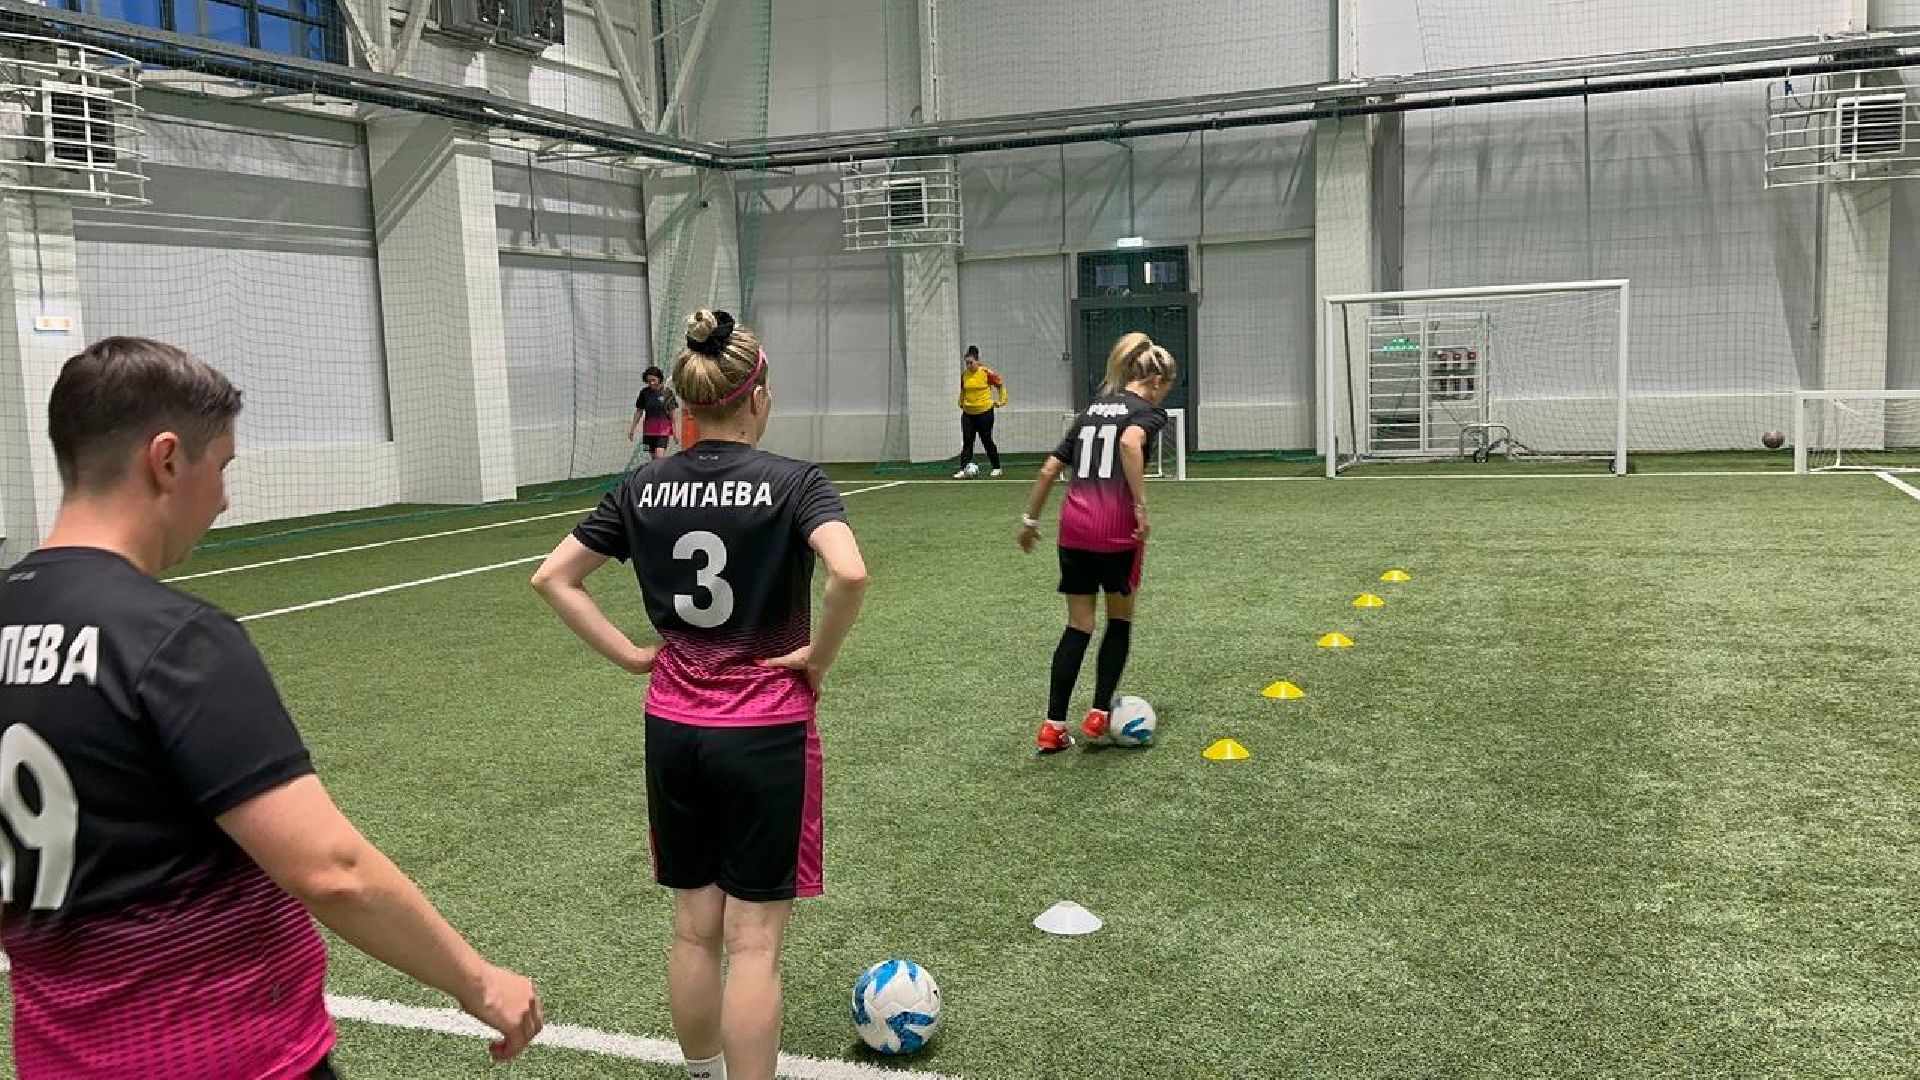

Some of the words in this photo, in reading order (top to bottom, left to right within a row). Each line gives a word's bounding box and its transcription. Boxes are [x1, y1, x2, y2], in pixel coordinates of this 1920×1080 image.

[1078, 424, 1117, 478] 11
[639, 481, 773, 508] АЛИГАЕВА
[673, 530, 734, 628] 3
[0, 722, 79, 910] 9
